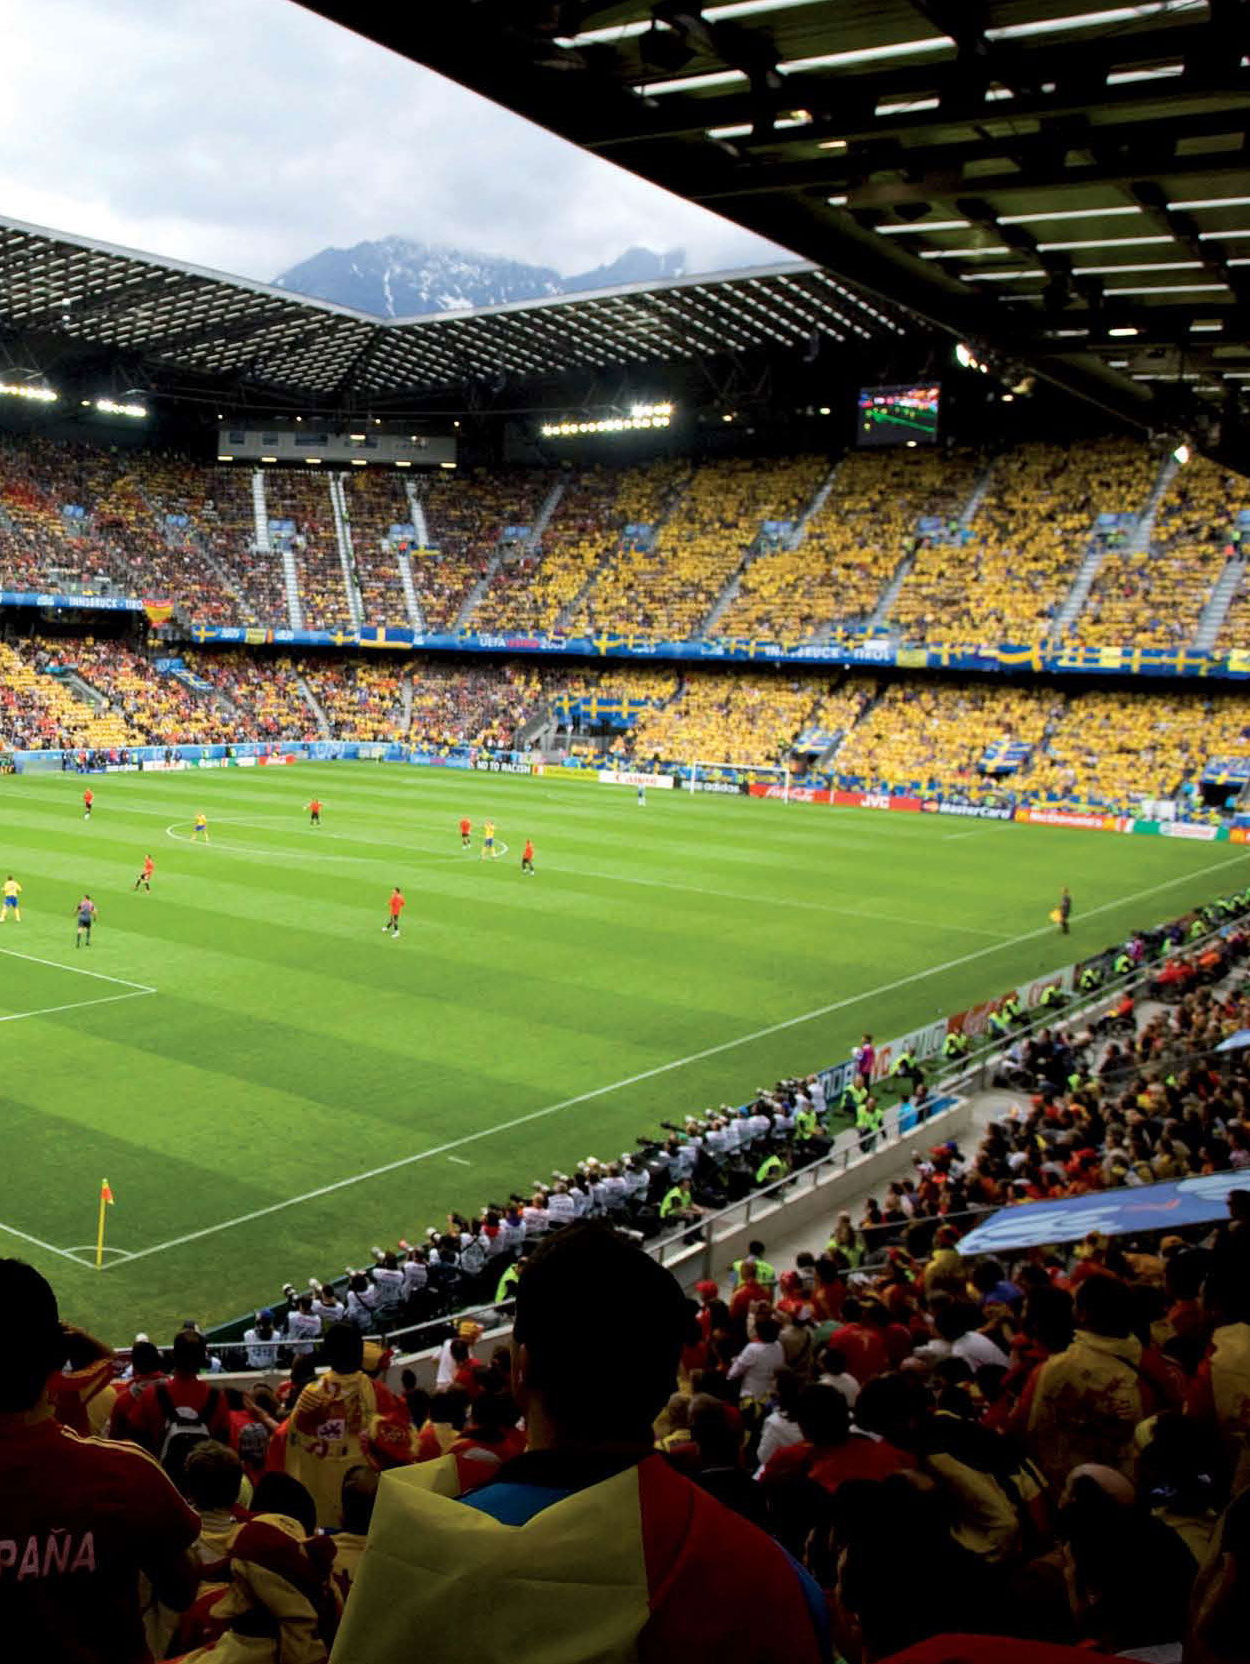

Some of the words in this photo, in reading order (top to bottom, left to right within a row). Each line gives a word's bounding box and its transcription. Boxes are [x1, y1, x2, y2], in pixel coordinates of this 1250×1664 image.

[479, 636, 507, 648] UEFA
[703, 781, 740, 793] adidas
[861, 794, 890, 810] JVC
